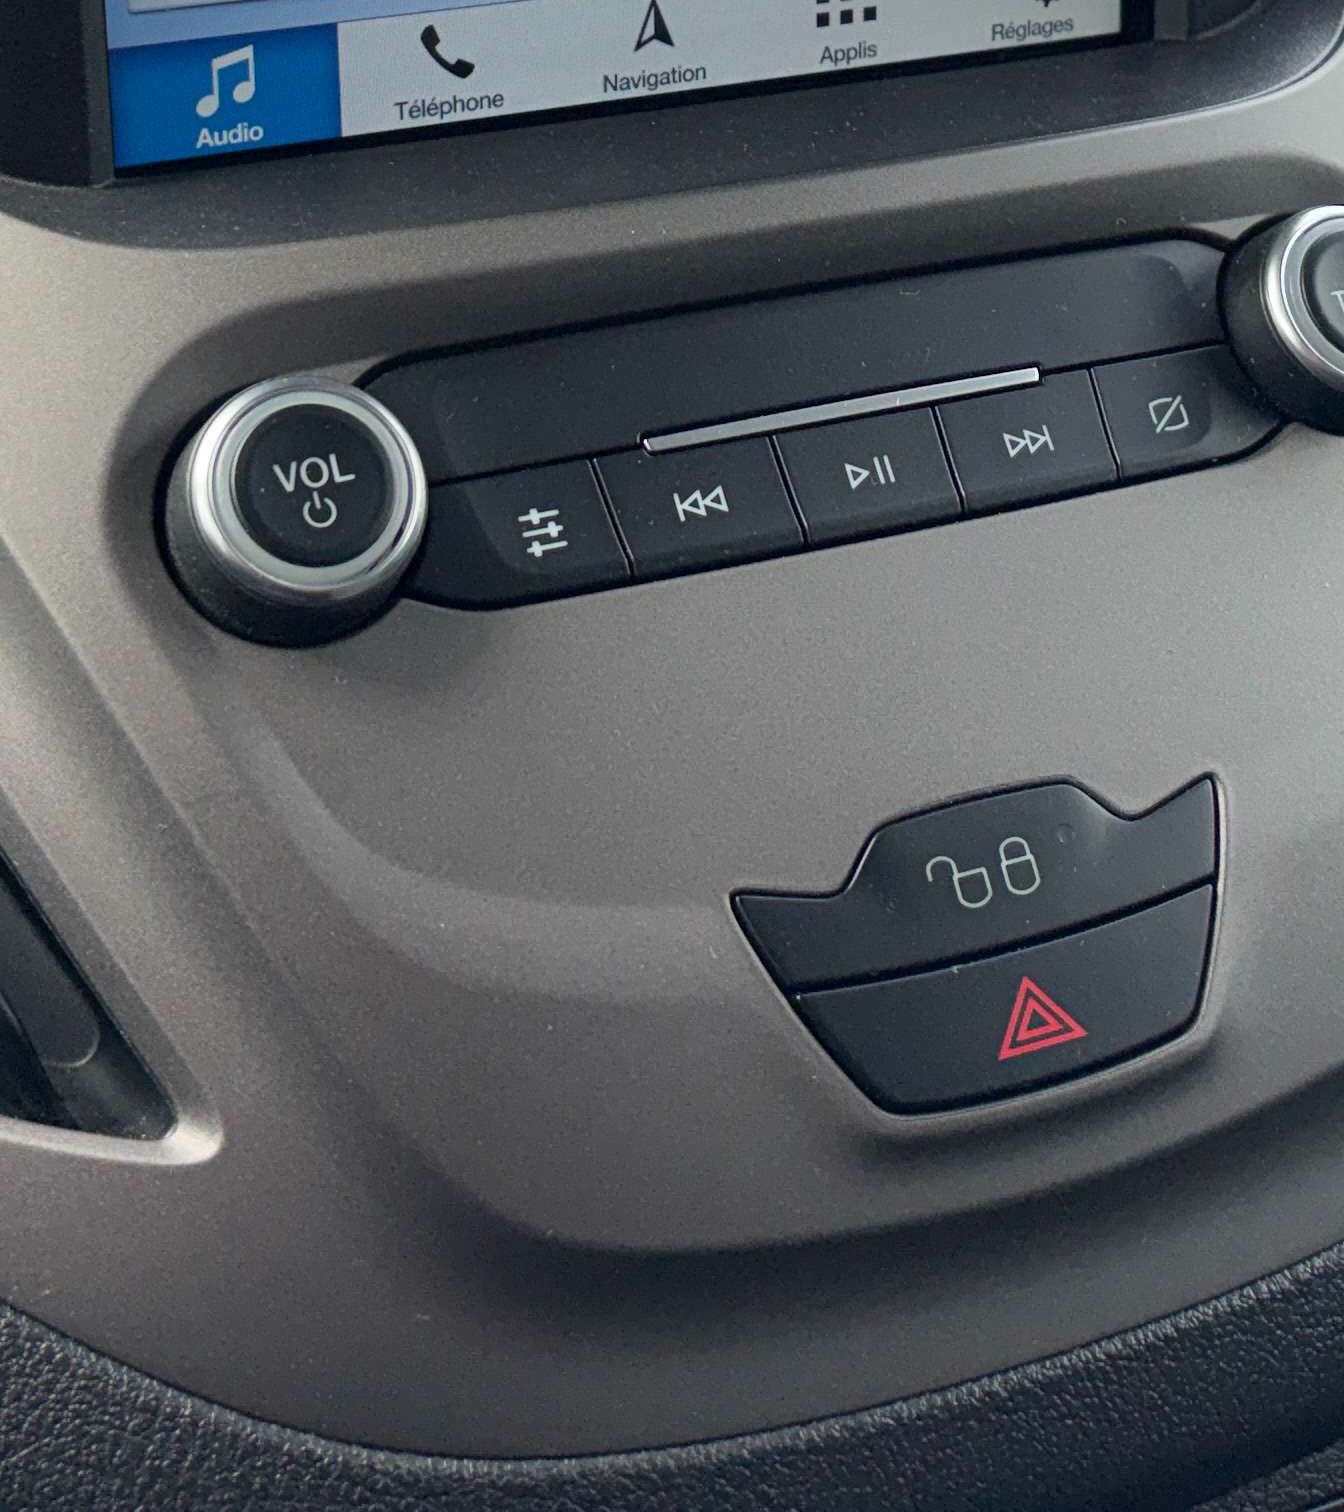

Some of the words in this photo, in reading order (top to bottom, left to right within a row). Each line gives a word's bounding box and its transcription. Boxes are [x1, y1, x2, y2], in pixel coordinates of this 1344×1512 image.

[991, 16, 1074, 44] Réglages
[820, 41, 878, 65] Applis
[603, 63, 707, 93] Navigation
[394, 91, 505, 122] Téléphone
[195, 122, 264, 149] Audio
[273, 455, 355, 494] VOL
